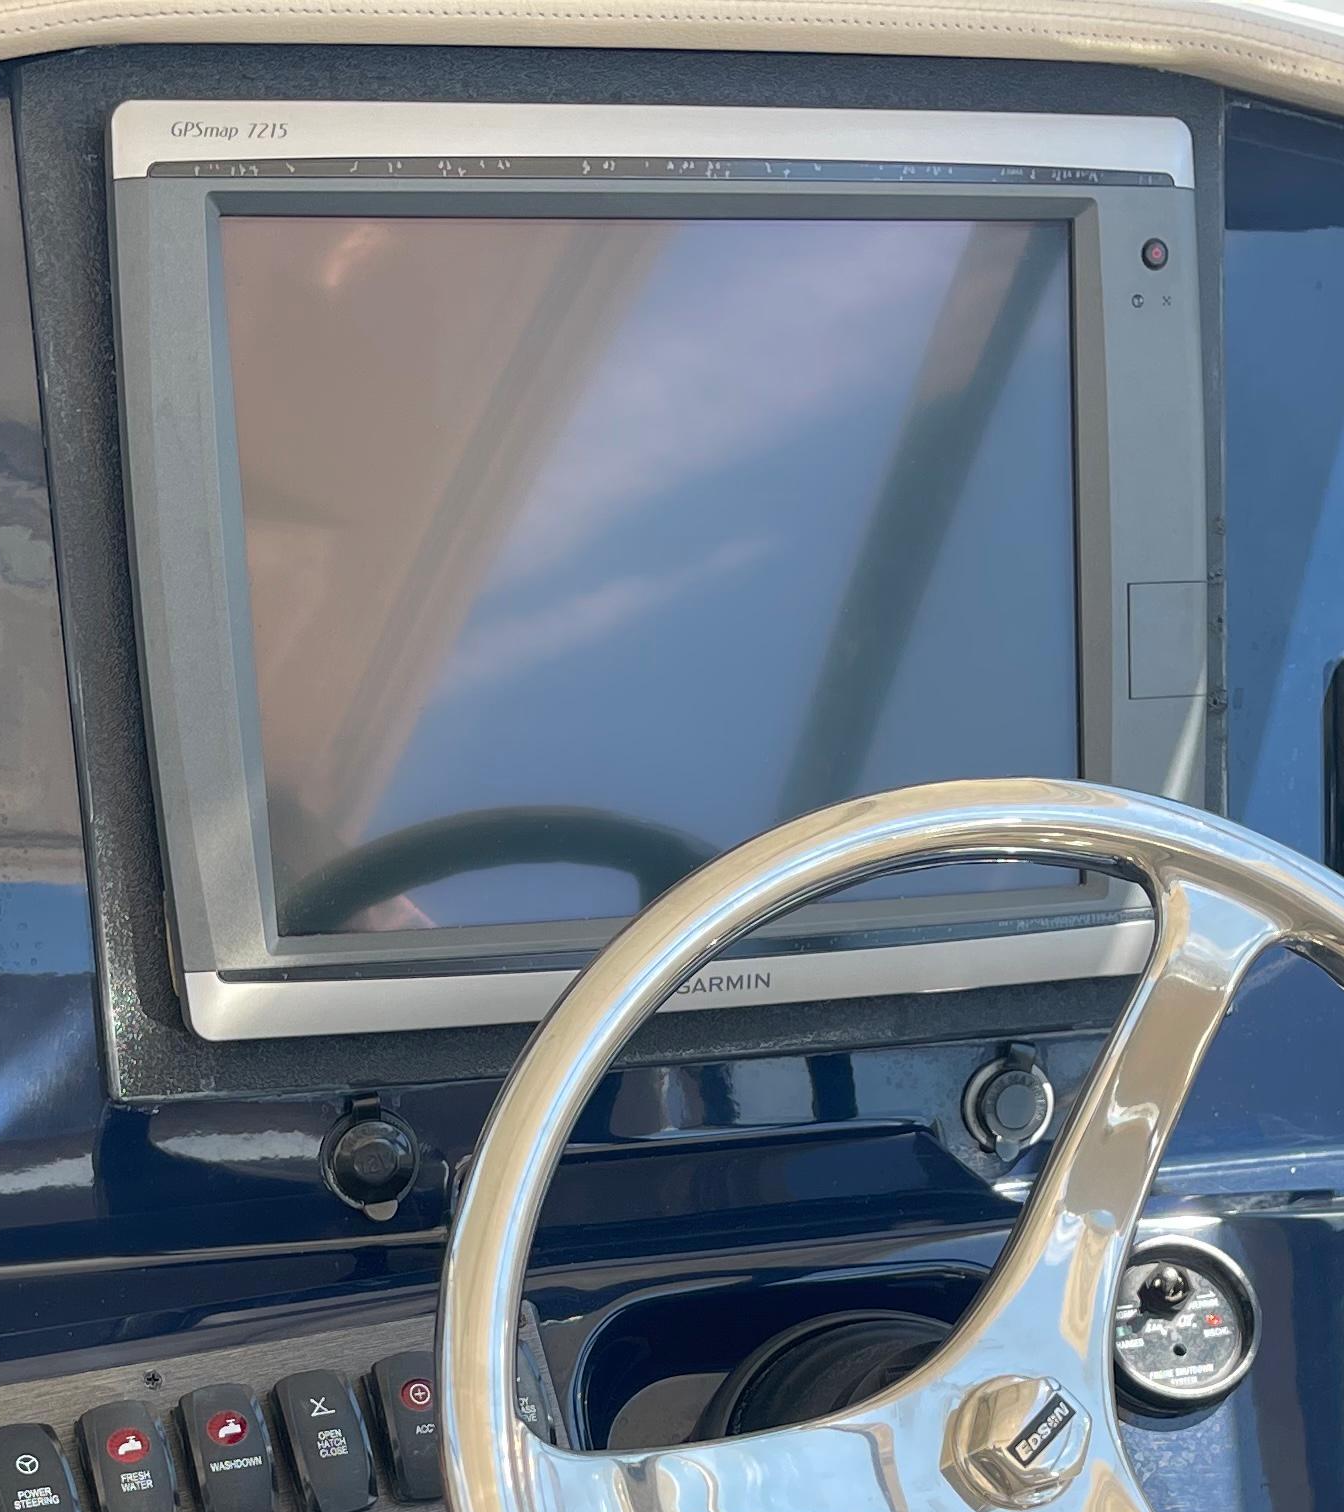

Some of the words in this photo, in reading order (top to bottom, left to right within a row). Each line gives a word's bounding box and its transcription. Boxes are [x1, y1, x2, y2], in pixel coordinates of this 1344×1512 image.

[170, 120, 239, 142] GPSmap
[246, 120, 288, 140] 7215
[318, 1429, 342, 1441] OPEN
[1014, 1401, 1070, 1461] EDSON
[317, 1437, 346, 1449] HATCH
[319, 1445, 348, 1458] CLOSE
[210, 1455, 263, 1472] WASHDOWN
[120, 1471, 151, 1484] FRESH
[17, 1486, 52, 1500] POWER
[120, 1479, 154, 1493] WATER
[13, 1495, 60, 1511] STEERING
